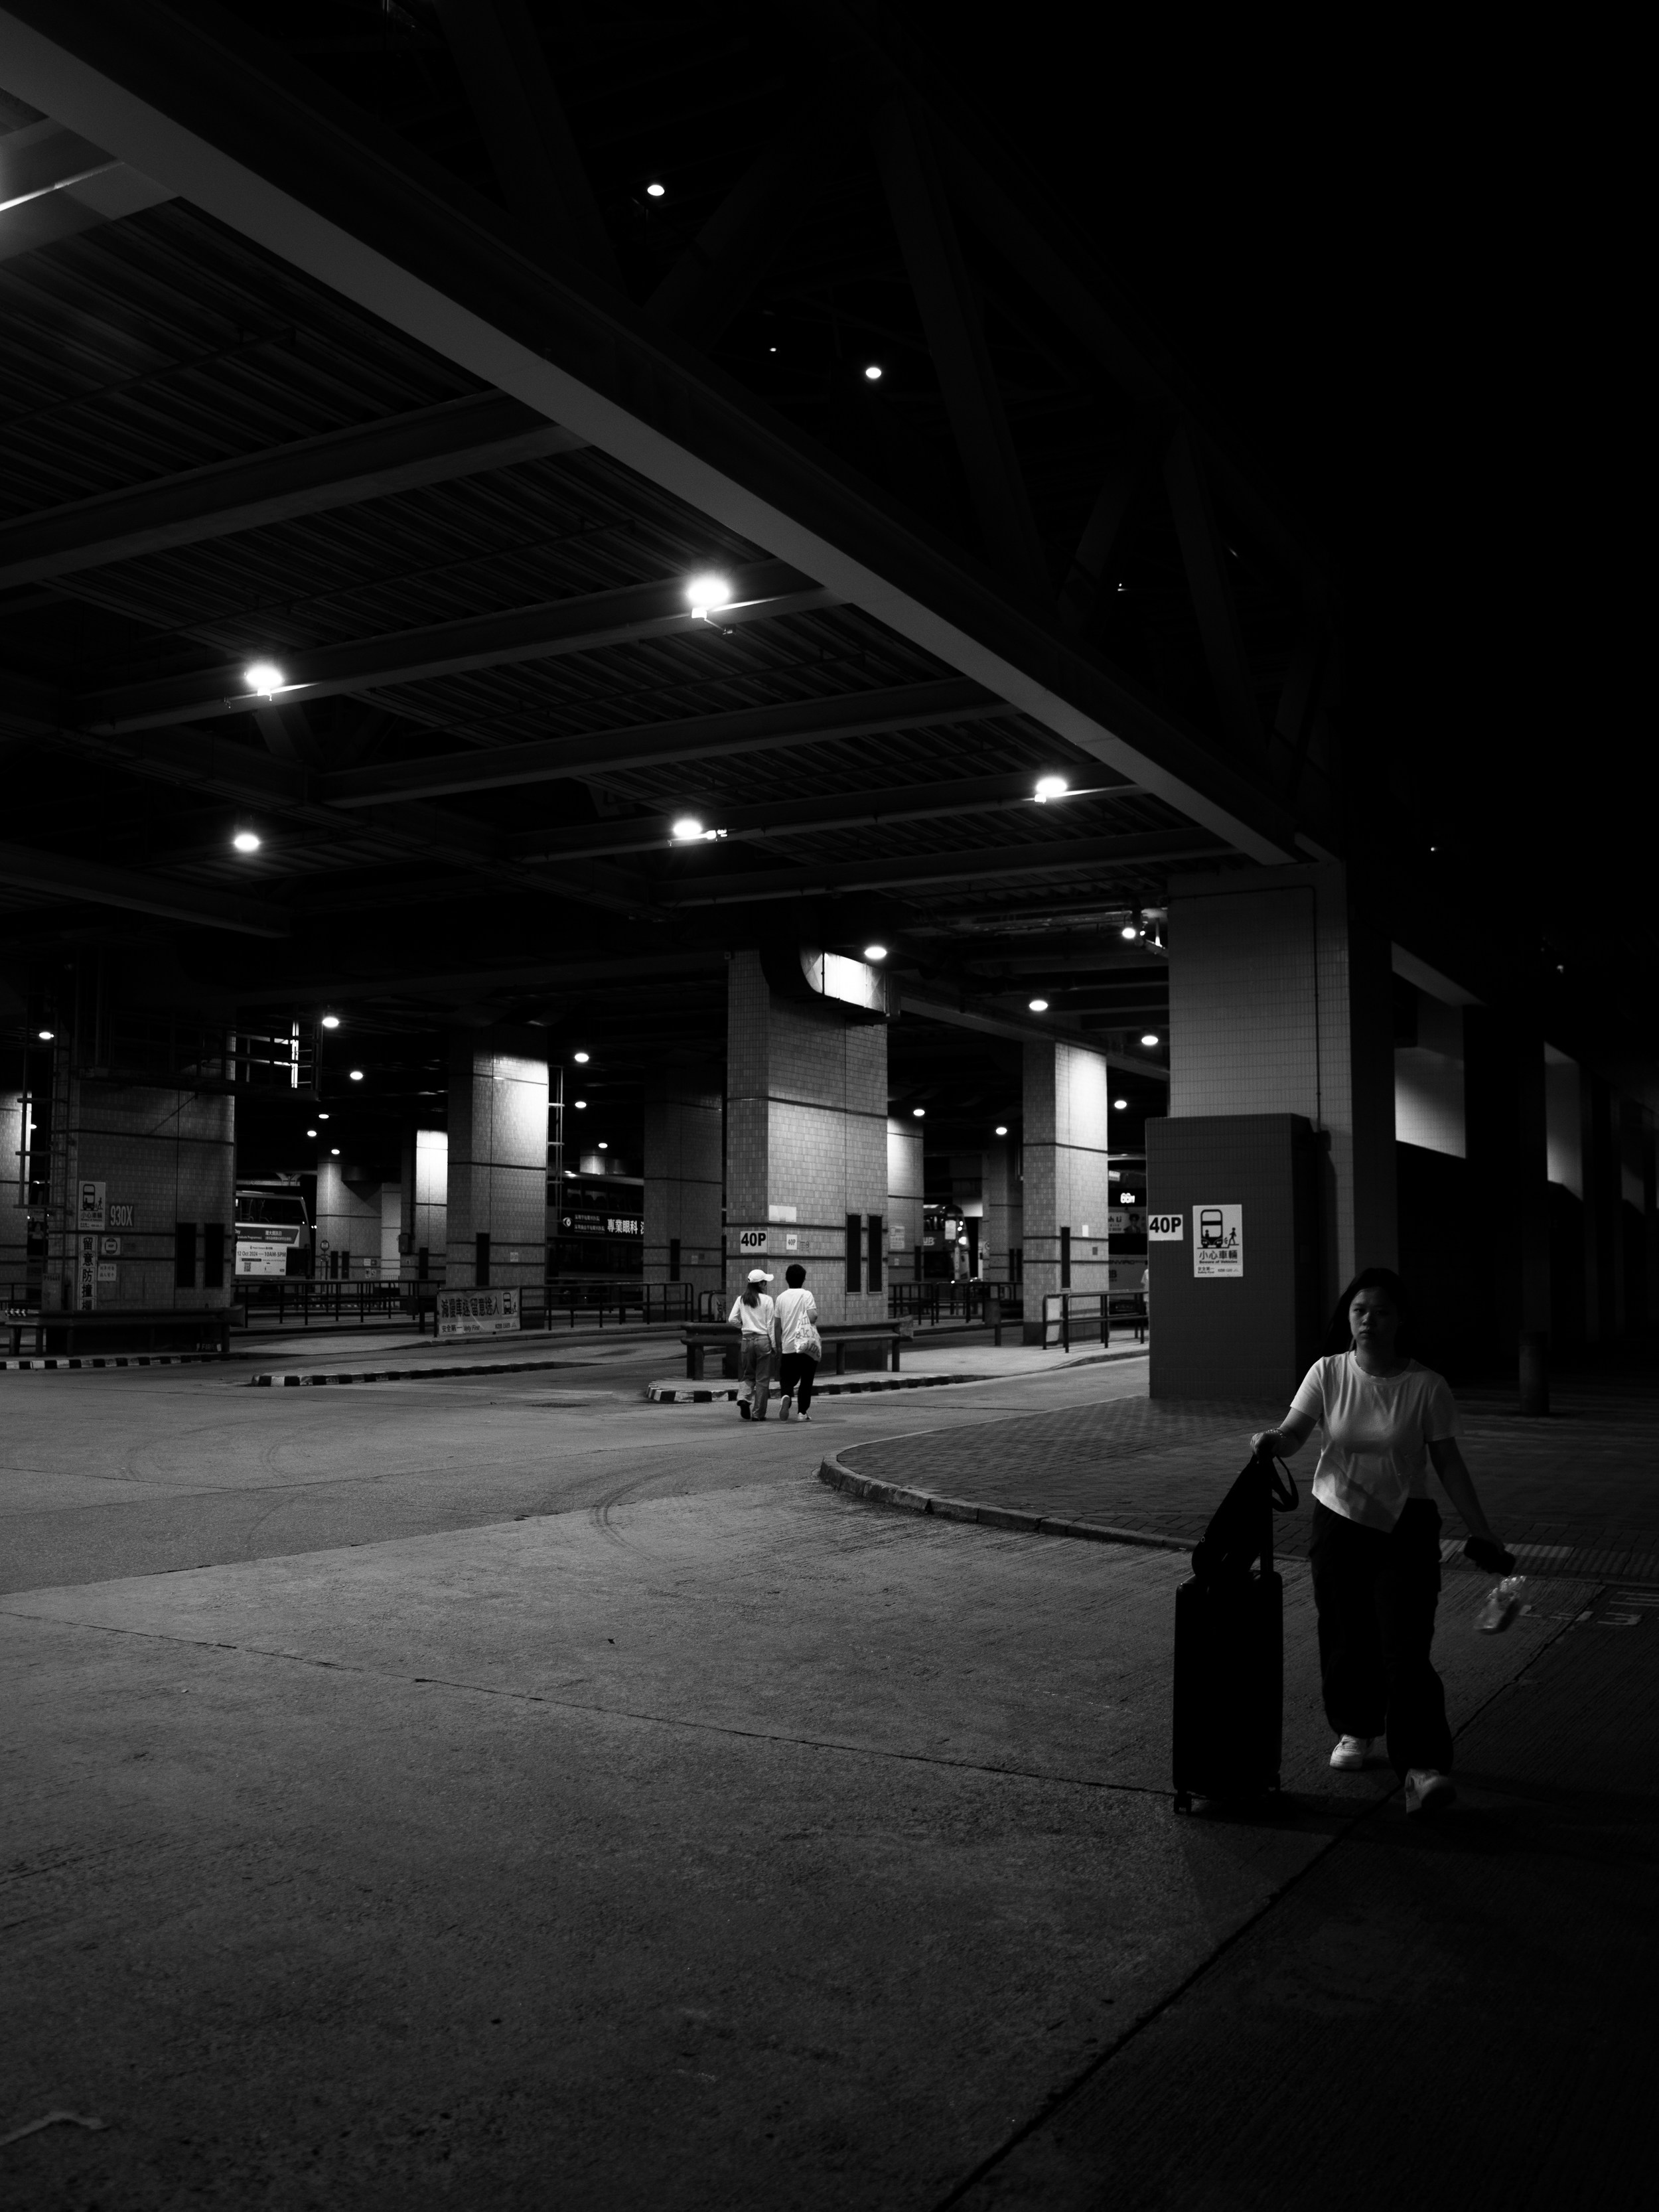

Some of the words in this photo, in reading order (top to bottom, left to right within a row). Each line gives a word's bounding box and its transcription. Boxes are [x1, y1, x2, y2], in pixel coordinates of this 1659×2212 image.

[110, 1205, 133, 1226] 930X
[607, 1218, 638, 1234] 專業眼科
[1149, 1217, 1181, 1232] 40P
[741, 1232, 766, 1246] 40P
[1199, 1250, 1238, 1260] 小心車輛
